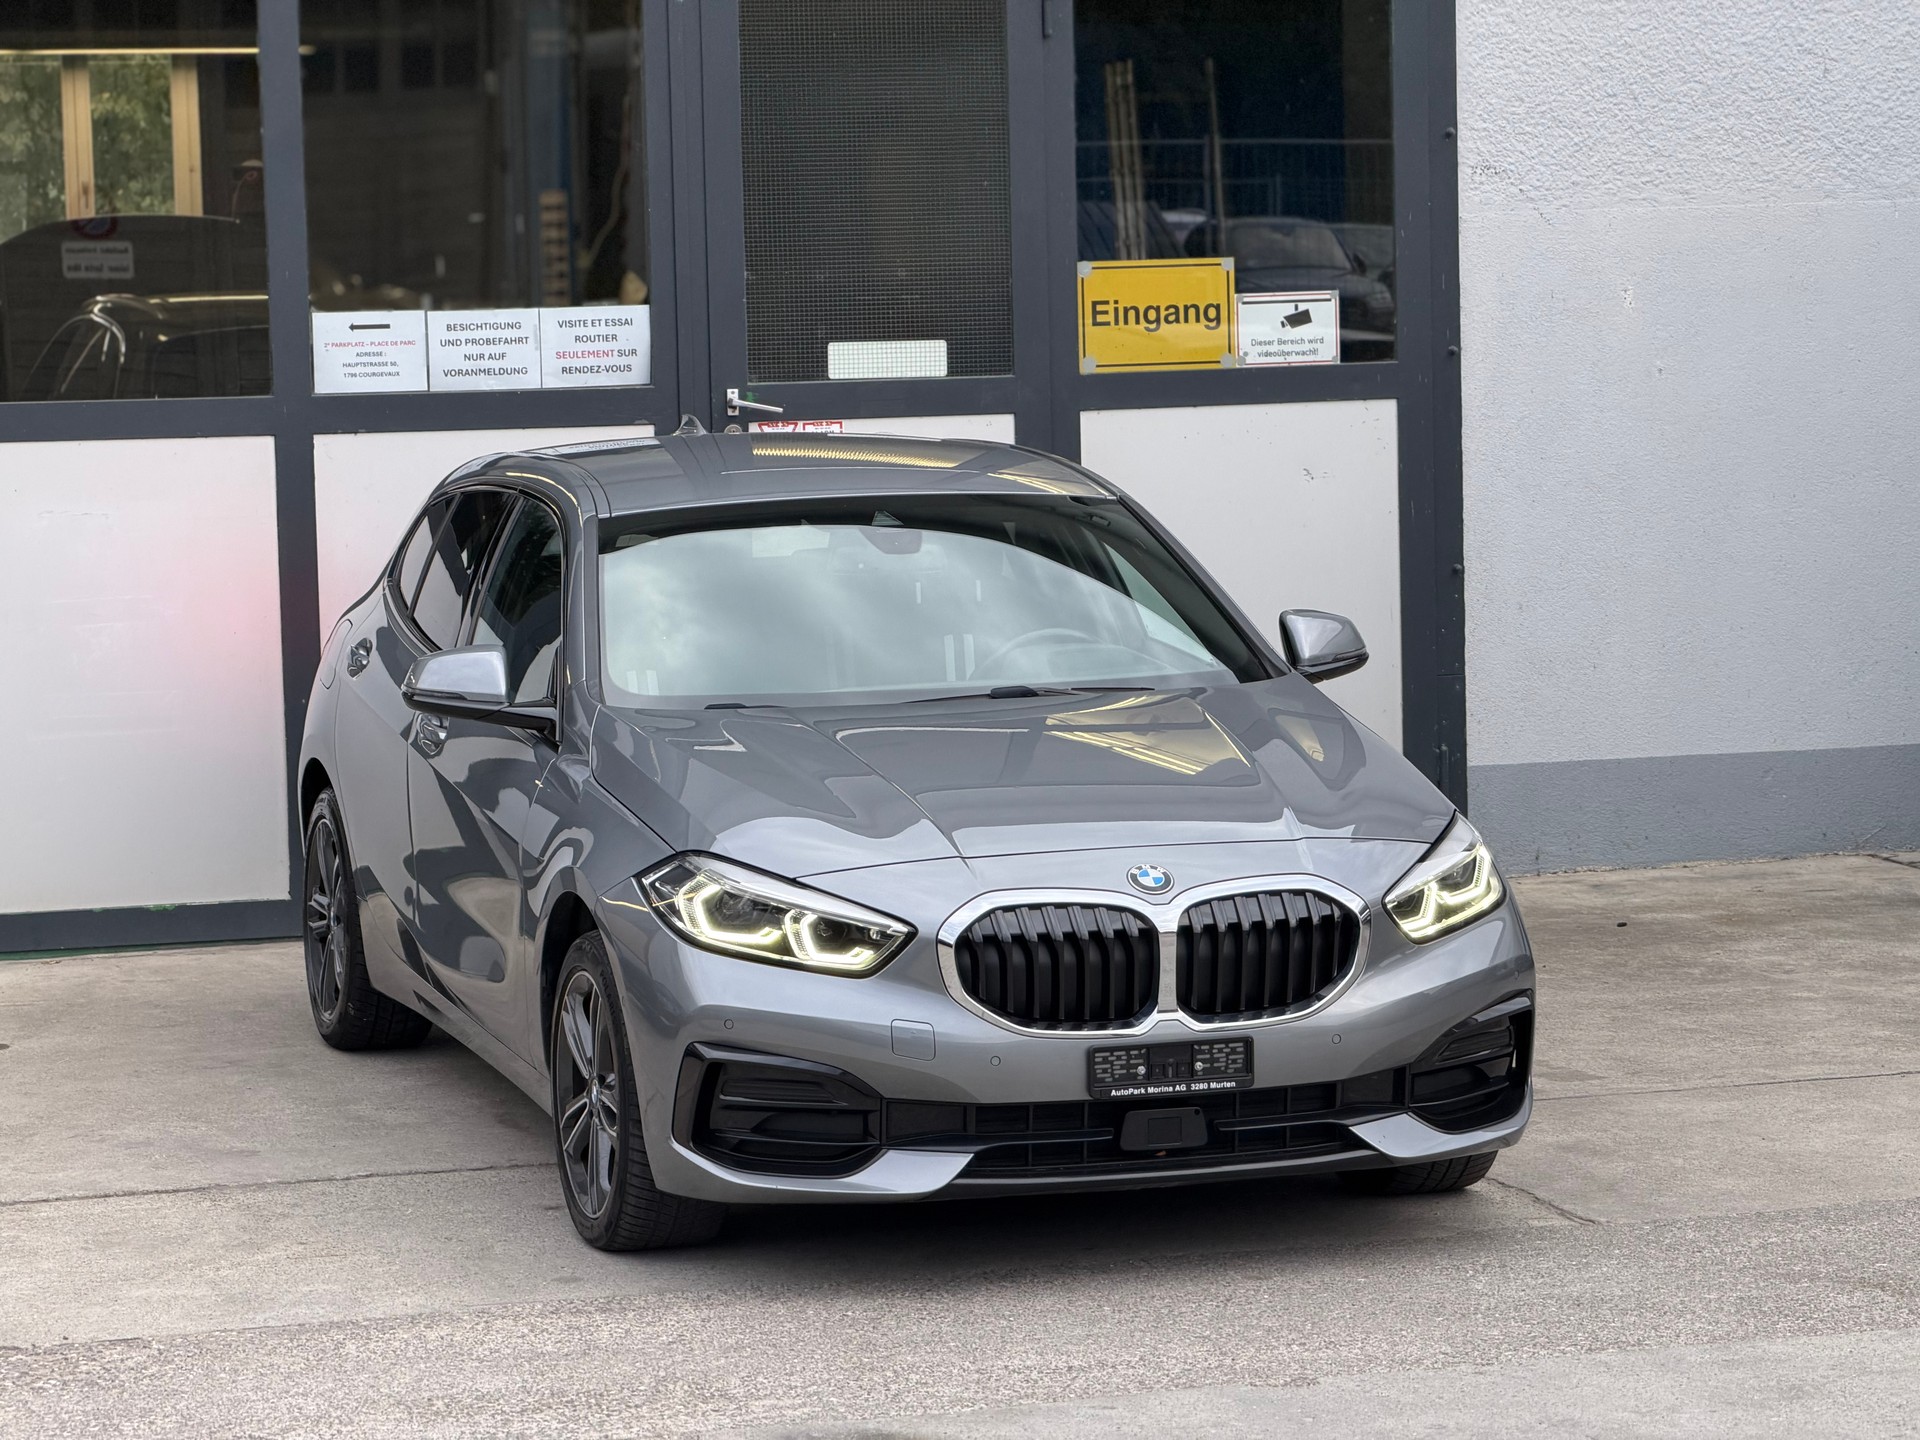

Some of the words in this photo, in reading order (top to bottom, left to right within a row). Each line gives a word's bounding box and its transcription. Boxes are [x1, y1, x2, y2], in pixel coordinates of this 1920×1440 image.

[1091, 300, 1221, 332] Eingang
[446, 321, 521, 332] BESICHTIGUNG
[557, 320, 588, 328] VISITE
[591, 319, 603, 327] ET
[605, 318, 633, 326] ESSAI
[440, 338, 462, 347] UND
[464, 336, 529, 346] PROBEFAHRT
[574, 334, 618, 343] ROUTIER
[1250, 338, 1275, 346] Dieser
[1277, 337, 1305, 345] Bereich
[1307, 336, 1324, 344] wird
[464, 353, 485, 361] NUR
[487, 352, 507, 361] AUF
[556, 350, 615, 359] SEULEMENT
[617, 349, 637, 357] SUR
[1257, 347, 1319, 358] videoüberwacht!
[443, 367, 528, 377] VORANMELDUNG
[561, 364, 632, 374] RENDEZ-VOUS
[1110, 1087, 1146, 1096] AutoPark
[1147, 1086, 1172, 1094] Morina
[1174, 1084, 1186, 1092] AG
[1190, 1082, 1208, 1090] 3280
[1210, 1081, 1236, 1089] Murten
